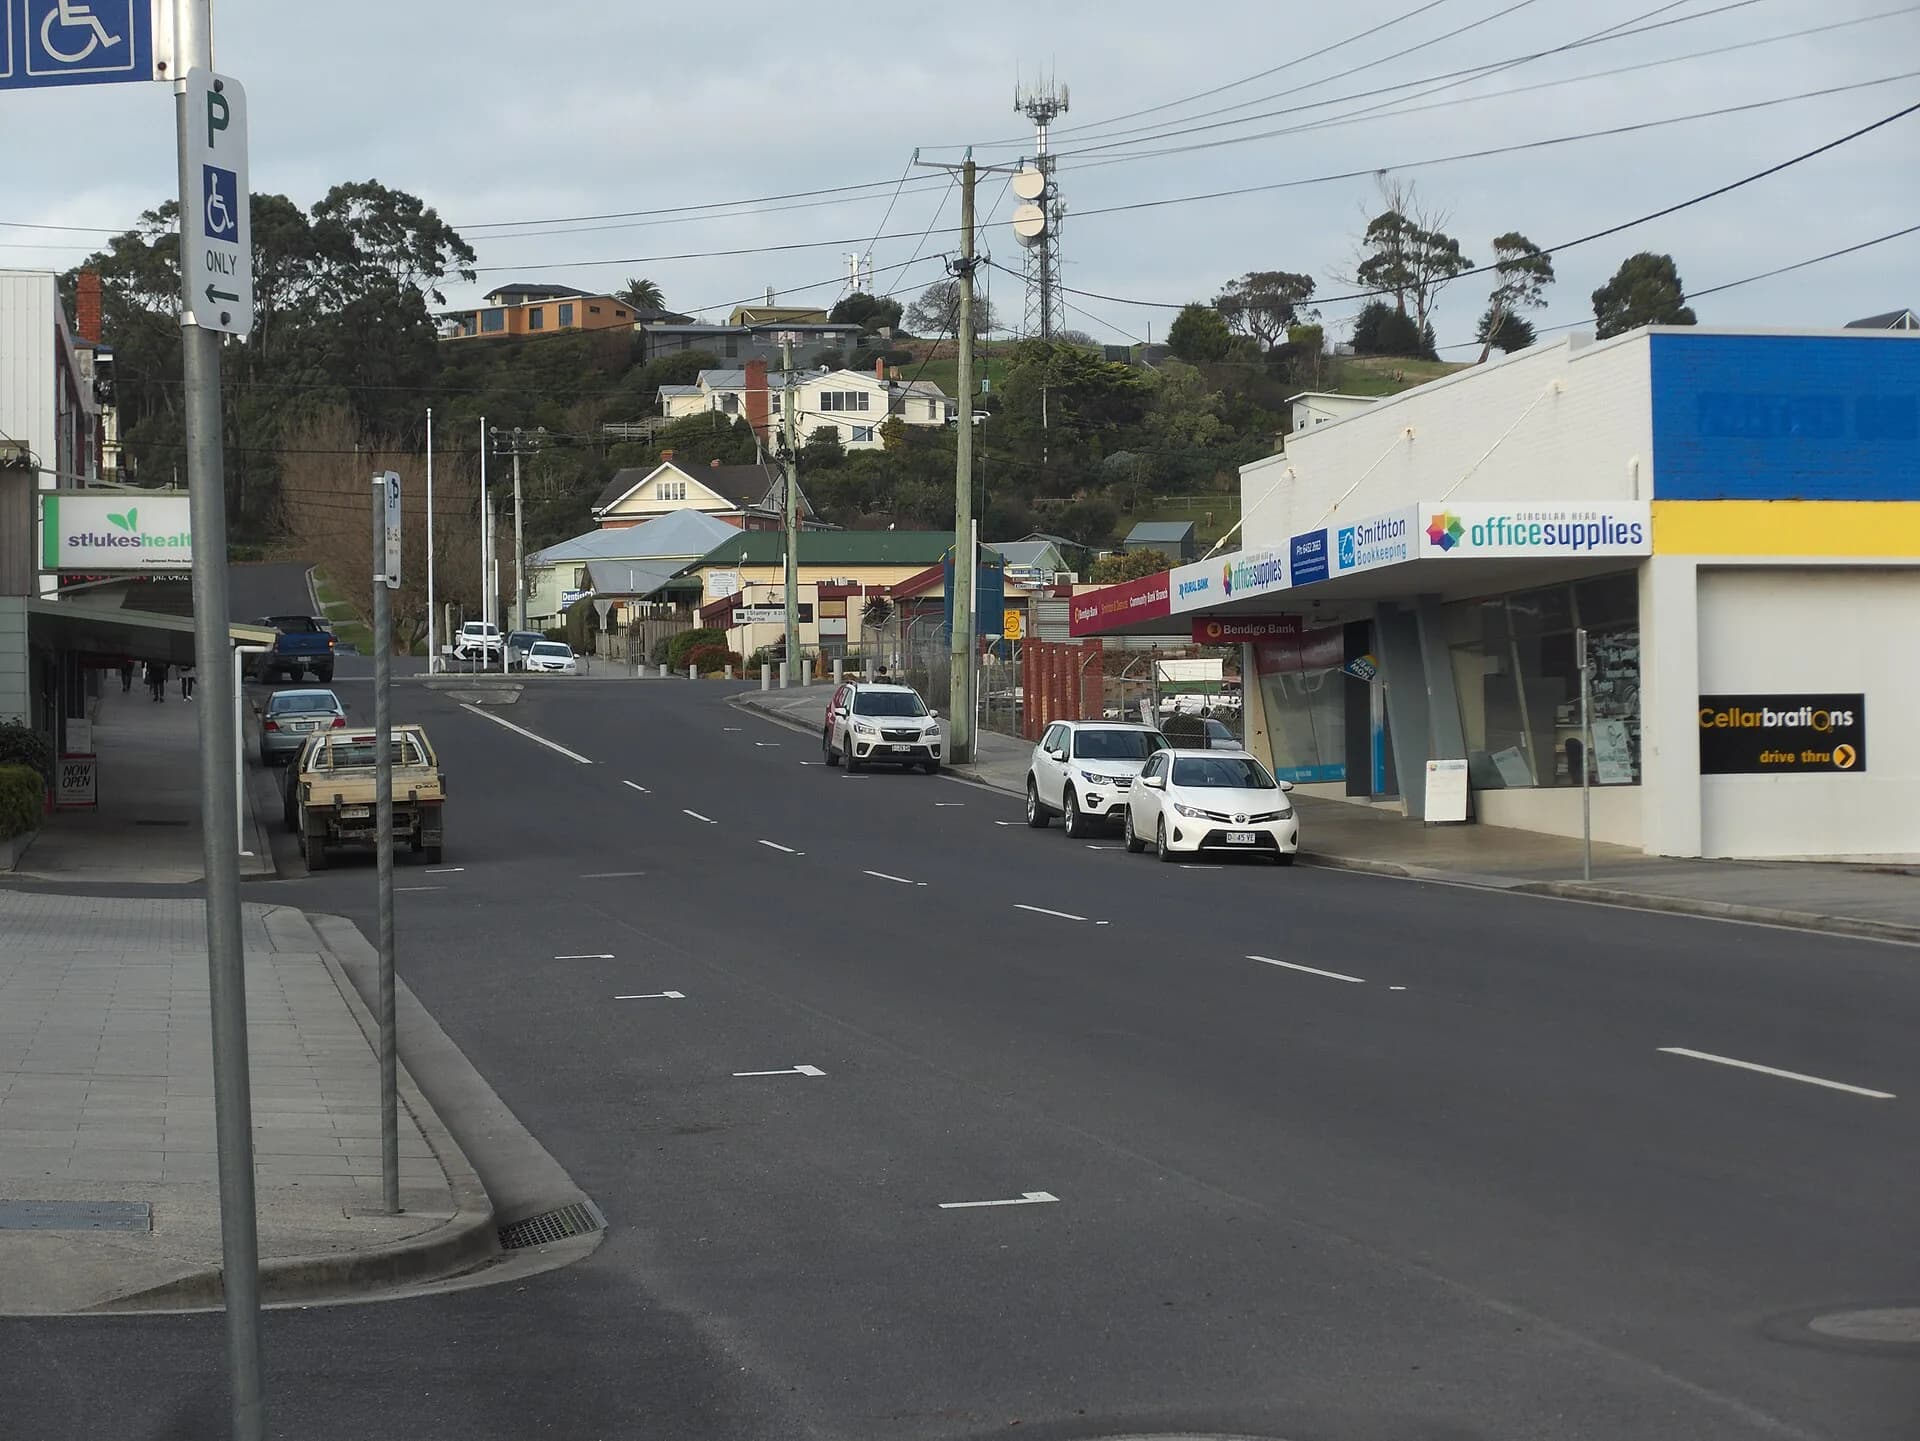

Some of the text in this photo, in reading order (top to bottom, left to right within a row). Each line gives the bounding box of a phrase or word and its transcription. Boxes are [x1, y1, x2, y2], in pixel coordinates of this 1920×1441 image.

[207, 90, 230, 149] P
[206, 250, 238, 276] ONLY
[1516, 512, 1597, 521] CIRCULAR HEAD
[68, 532, 192, 548] stlukeshealt
[1357, 517, 1406, 546] Smithton
[1471, 515, 1643, 550] officesupplies
[1357, 543, 1407, 566] Bookkeeping
[1233, 559, 1282, 591] officesupplies
[1223, 624, 1295, 636] Bendigo Bank
[1699, 706, 1854, 731] Cellarbrations
[1760, 750, 1830, 764] drive thru
[62, 775, 91, 788] OPEN
[63, 764, 91, 777] NOW
